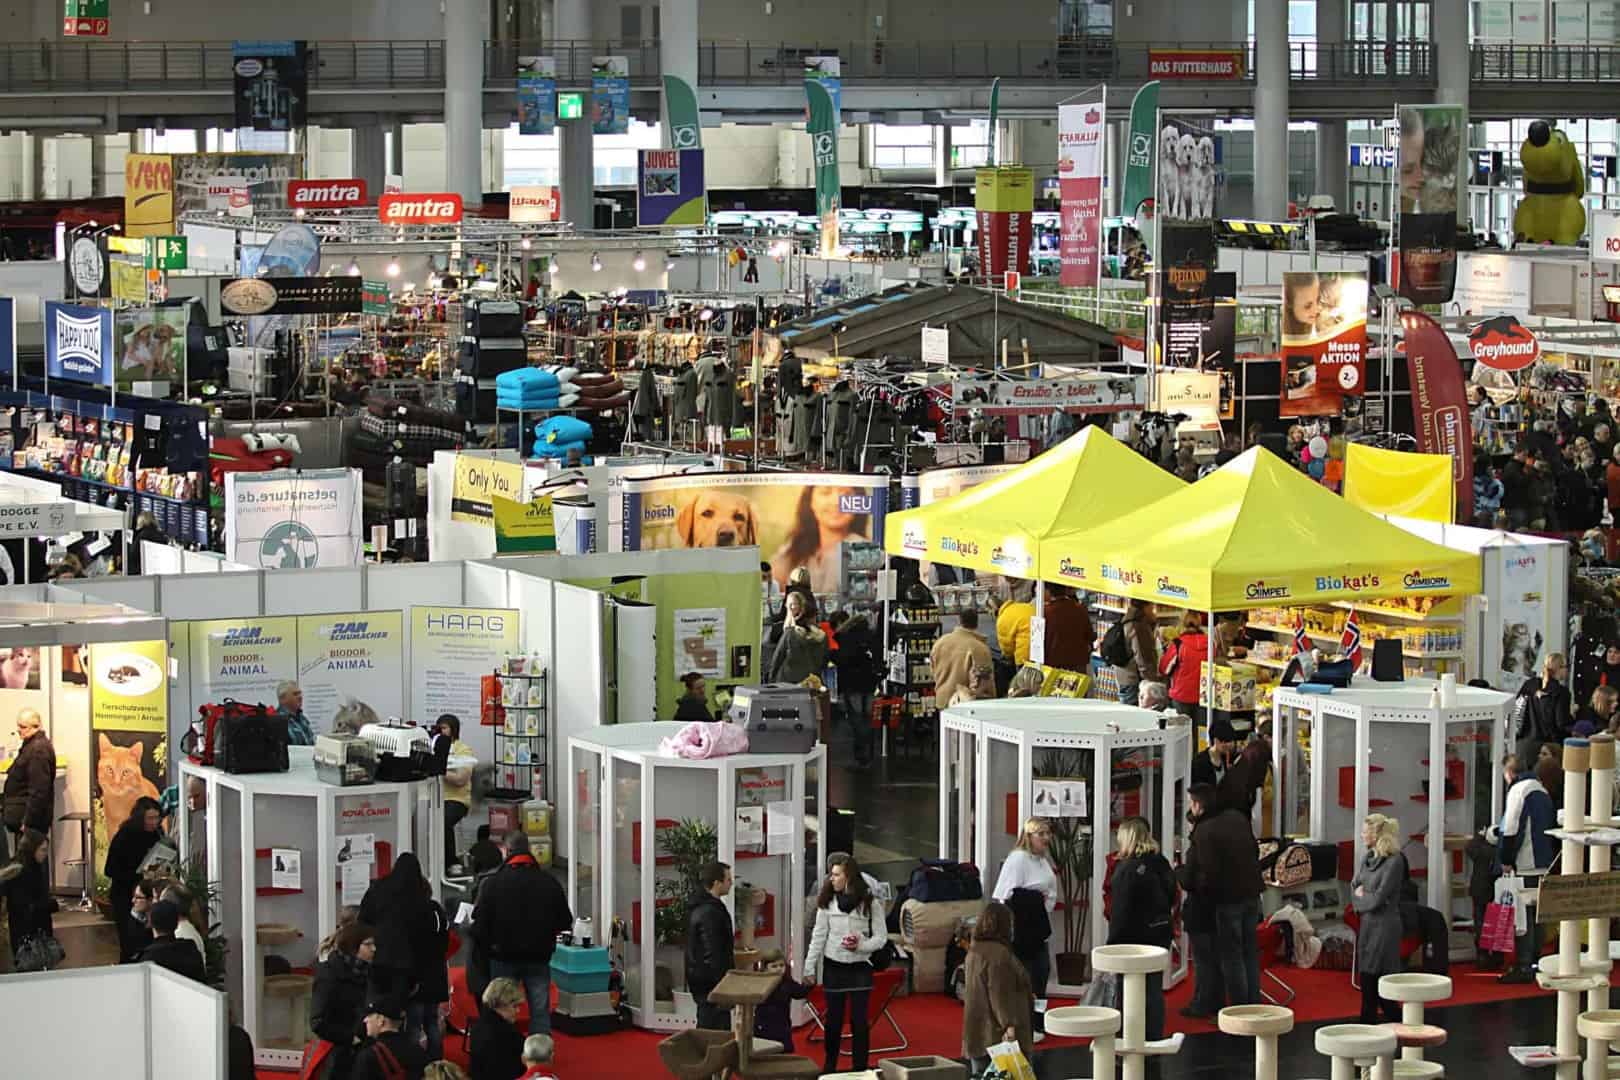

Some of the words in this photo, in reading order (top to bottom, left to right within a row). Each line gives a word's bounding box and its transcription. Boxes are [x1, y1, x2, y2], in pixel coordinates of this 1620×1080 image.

[1152, 61, 1170, 73] DAS
[1172, 61, 1233, 73] FUTTERHAUS
[645, 151, 678, 169] JUWEL
[295, 185, 360, 202] amtra
[386, 200, 455, 218] amtra
[1009, 213, 1020, 233] DAS
[59, 320, 82, 350] HAPPY
[83, 327, 99, 356] DOG
[1328, 341, 1361, 352] Messe
[1320, 352, 1361, 364] AKTION
[1473, 339, 1535, 360] Greyhound
[468, 468, 489, 492] Only
[492, 471, 509, 492] You
[1, 506, 41, 517] DOGGE
[644, 504, 675, 520] bosch
[841, 496, 872, 510] NEU
[941, 536, 979, 557] Biokat's
[1101, 563, 1144, 586] Biokat's
[1315, 572, 1380, 592] Biokat's
[428, 613, 504, 632] HAAG
[220, 664, 267, 676] ANIMAL
[327, 658, 374, 671] ANIMAL
